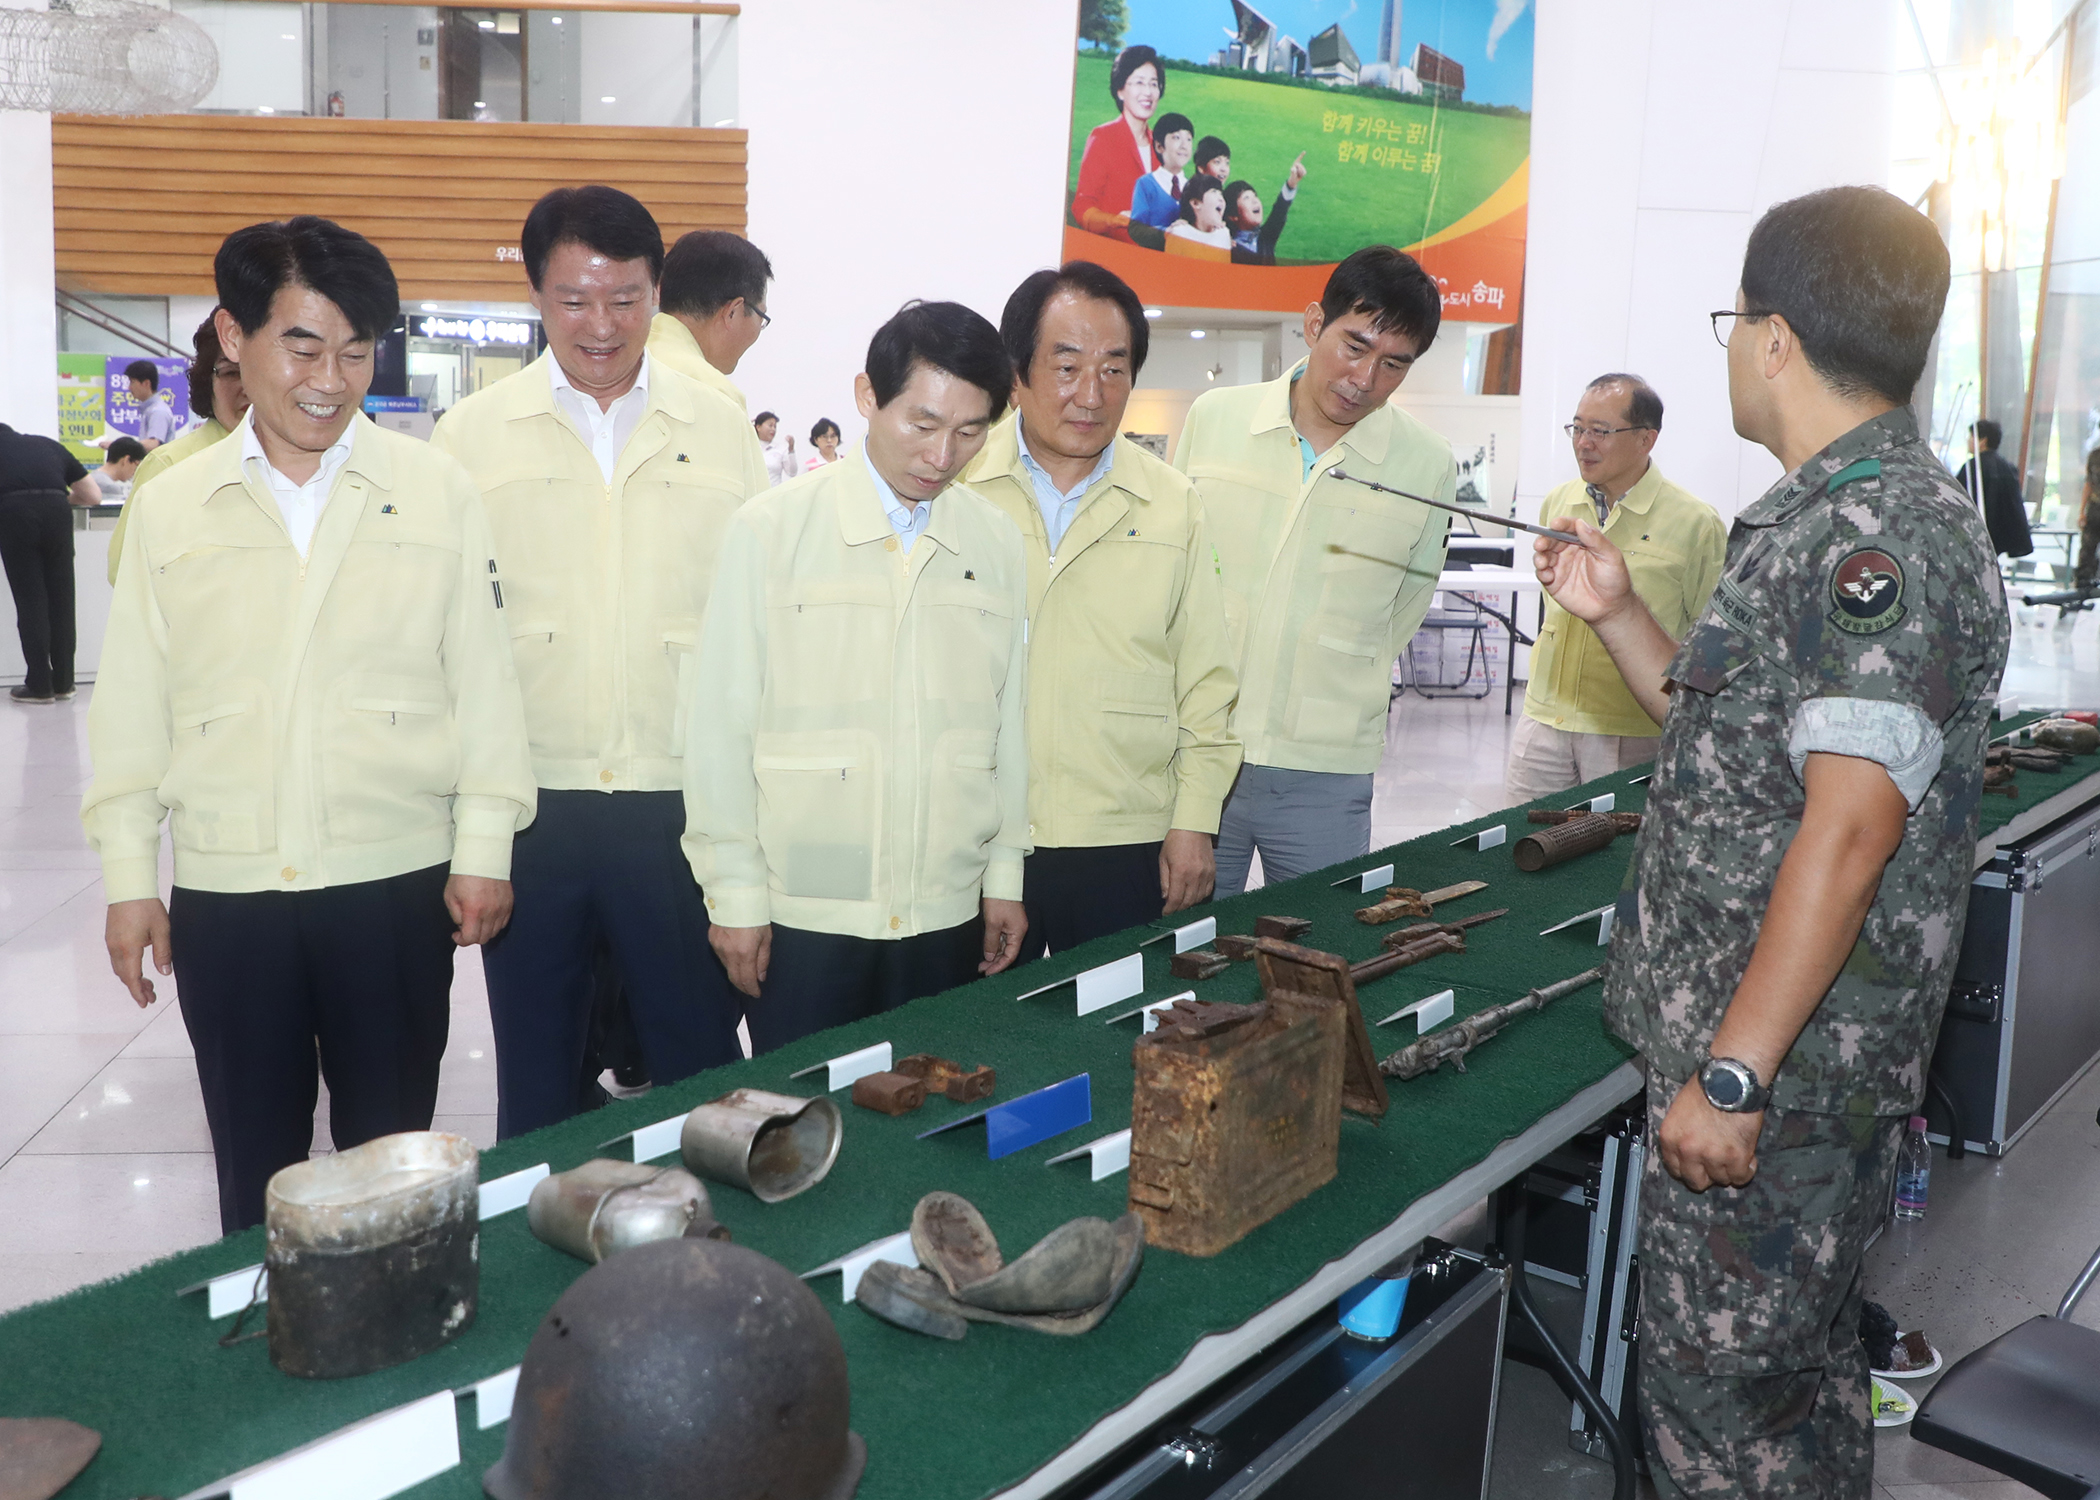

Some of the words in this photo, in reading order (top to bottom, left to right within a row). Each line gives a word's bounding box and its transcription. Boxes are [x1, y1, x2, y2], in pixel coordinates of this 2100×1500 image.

[1322, 110, 1354, 135] 함께
[1355, 117, 1402, 142] 키우는
[1406, 122, 1428, 145] 꿈!
[1338, 140, 1370, 165] 함께
[1372, 146, 1417, 171] 이루는
[495, 246, 524, 262] 우리
[1471, 279, 1506, 310] 송파
[111, 391, 141, 407] 주민
[111, 408, 142, 424] 납부
[1731, 605, 1753, 627] ROKA
